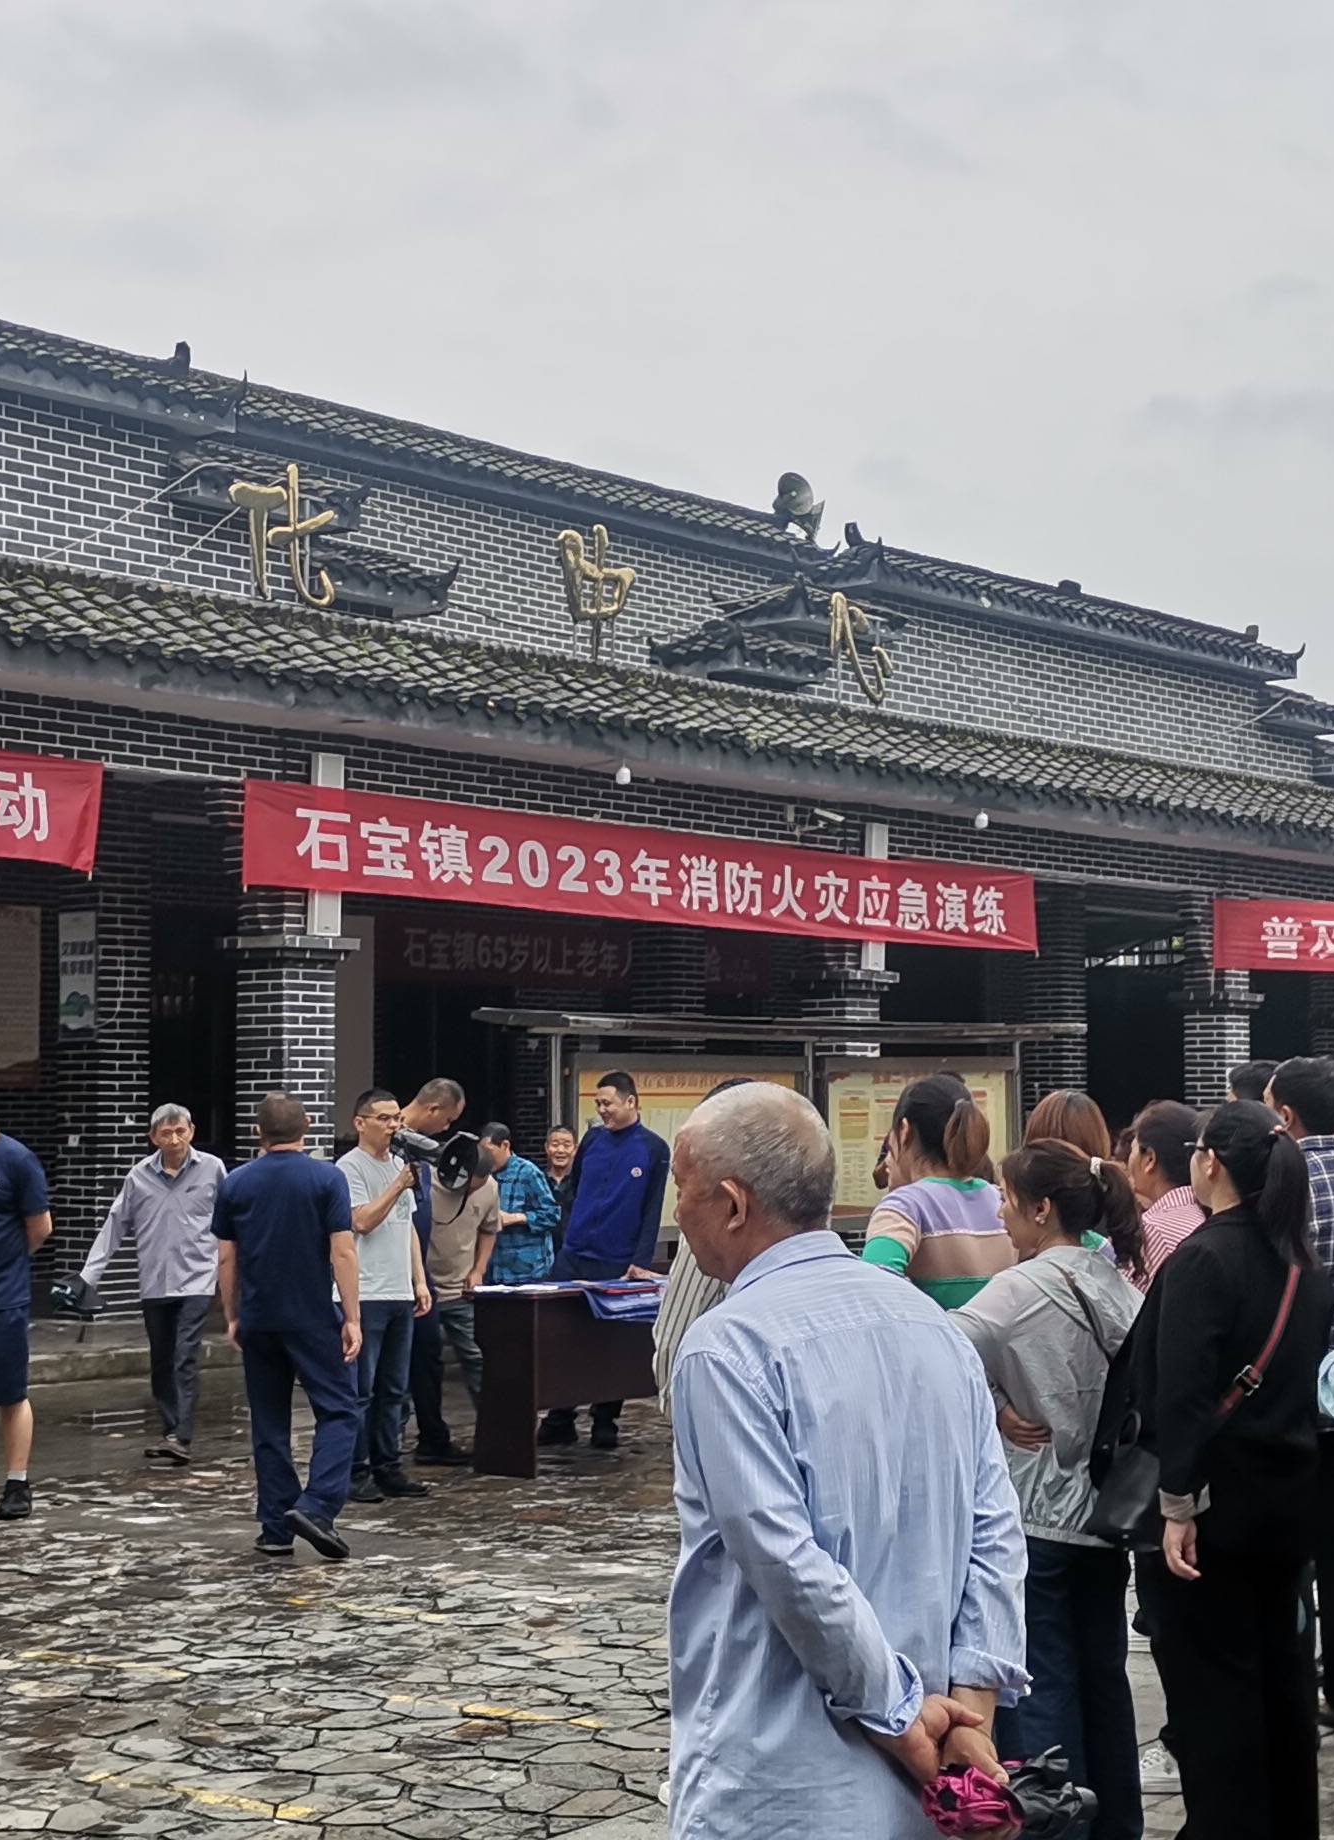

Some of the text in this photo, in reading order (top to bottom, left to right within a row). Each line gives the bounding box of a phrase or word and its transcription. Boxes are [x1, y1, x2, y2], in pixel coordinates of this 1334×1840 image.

[296, 807, 1007, 936] 石宝镇2023年消防火灾应急演练
